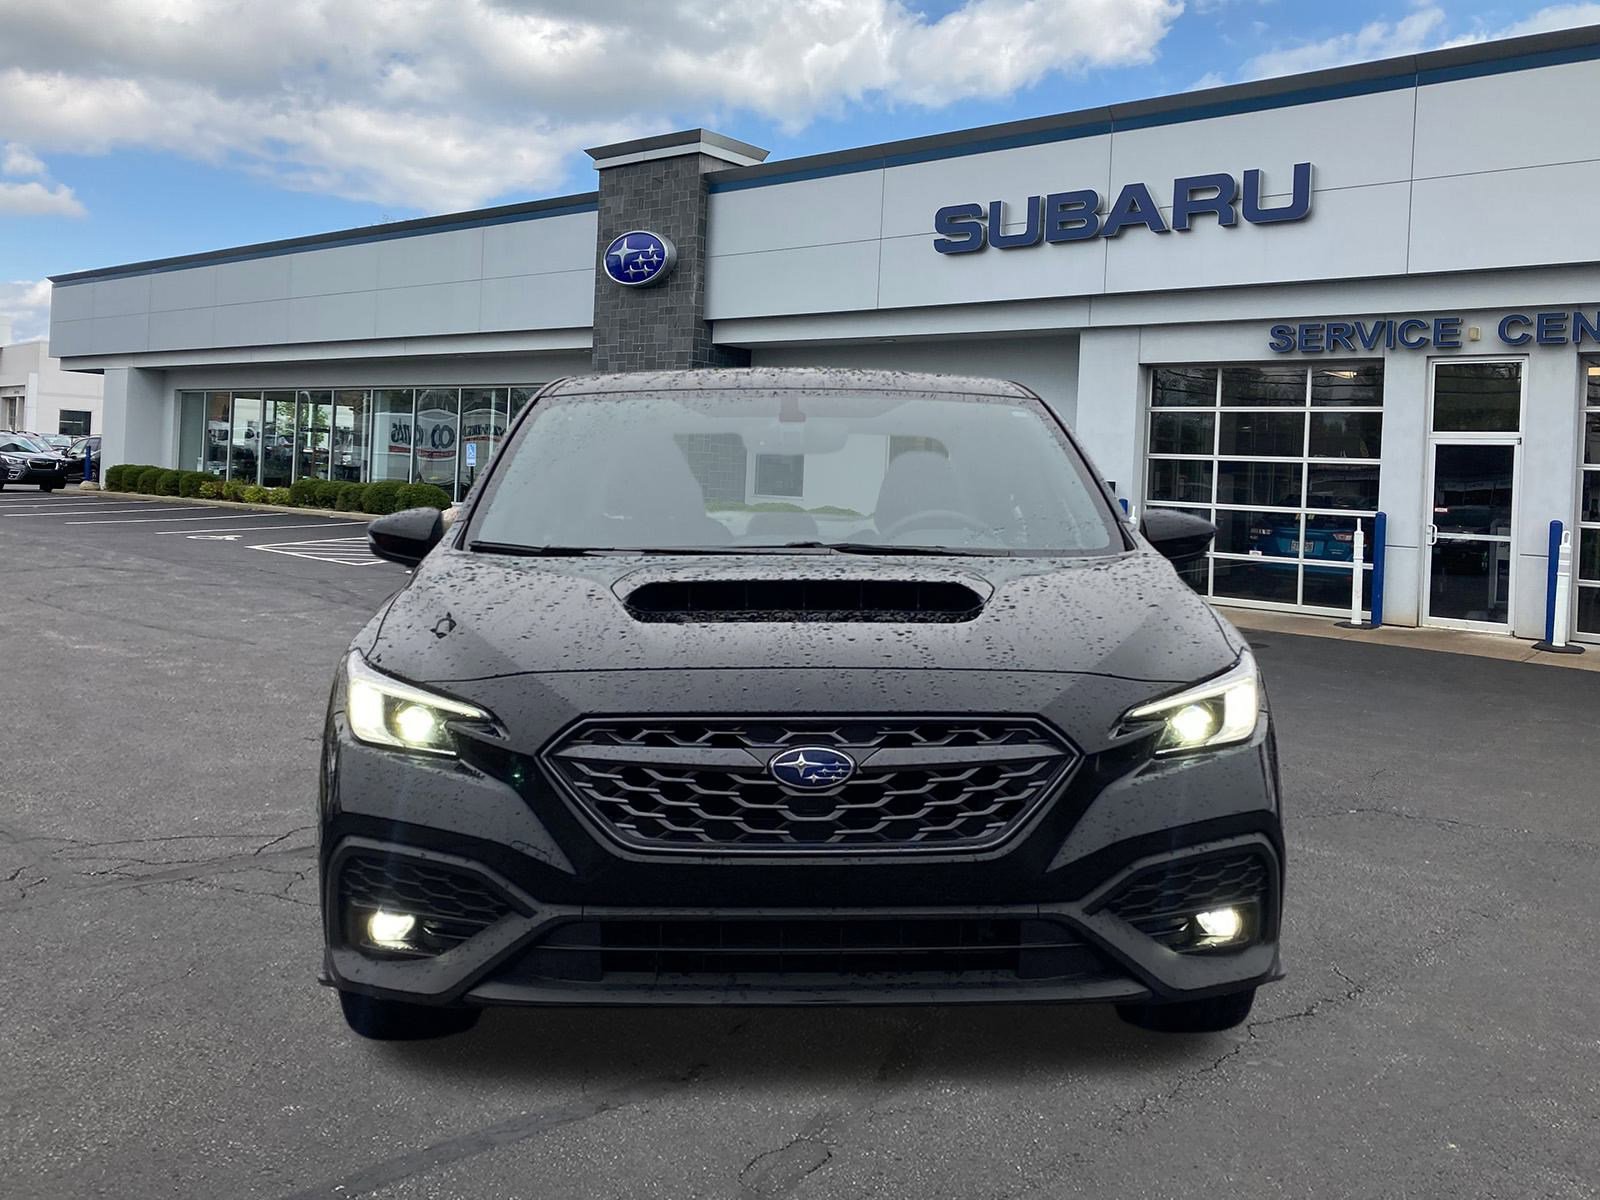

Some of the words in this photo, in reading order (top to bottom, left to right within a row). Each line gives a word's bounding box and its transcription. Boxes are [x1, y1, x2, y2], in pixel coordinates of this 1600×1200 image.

[933, 161, 1314, 255] SUBARU
[1268, 317, 1464, 354] SERVICE
[1497, 311, 1600, 346] CEN
